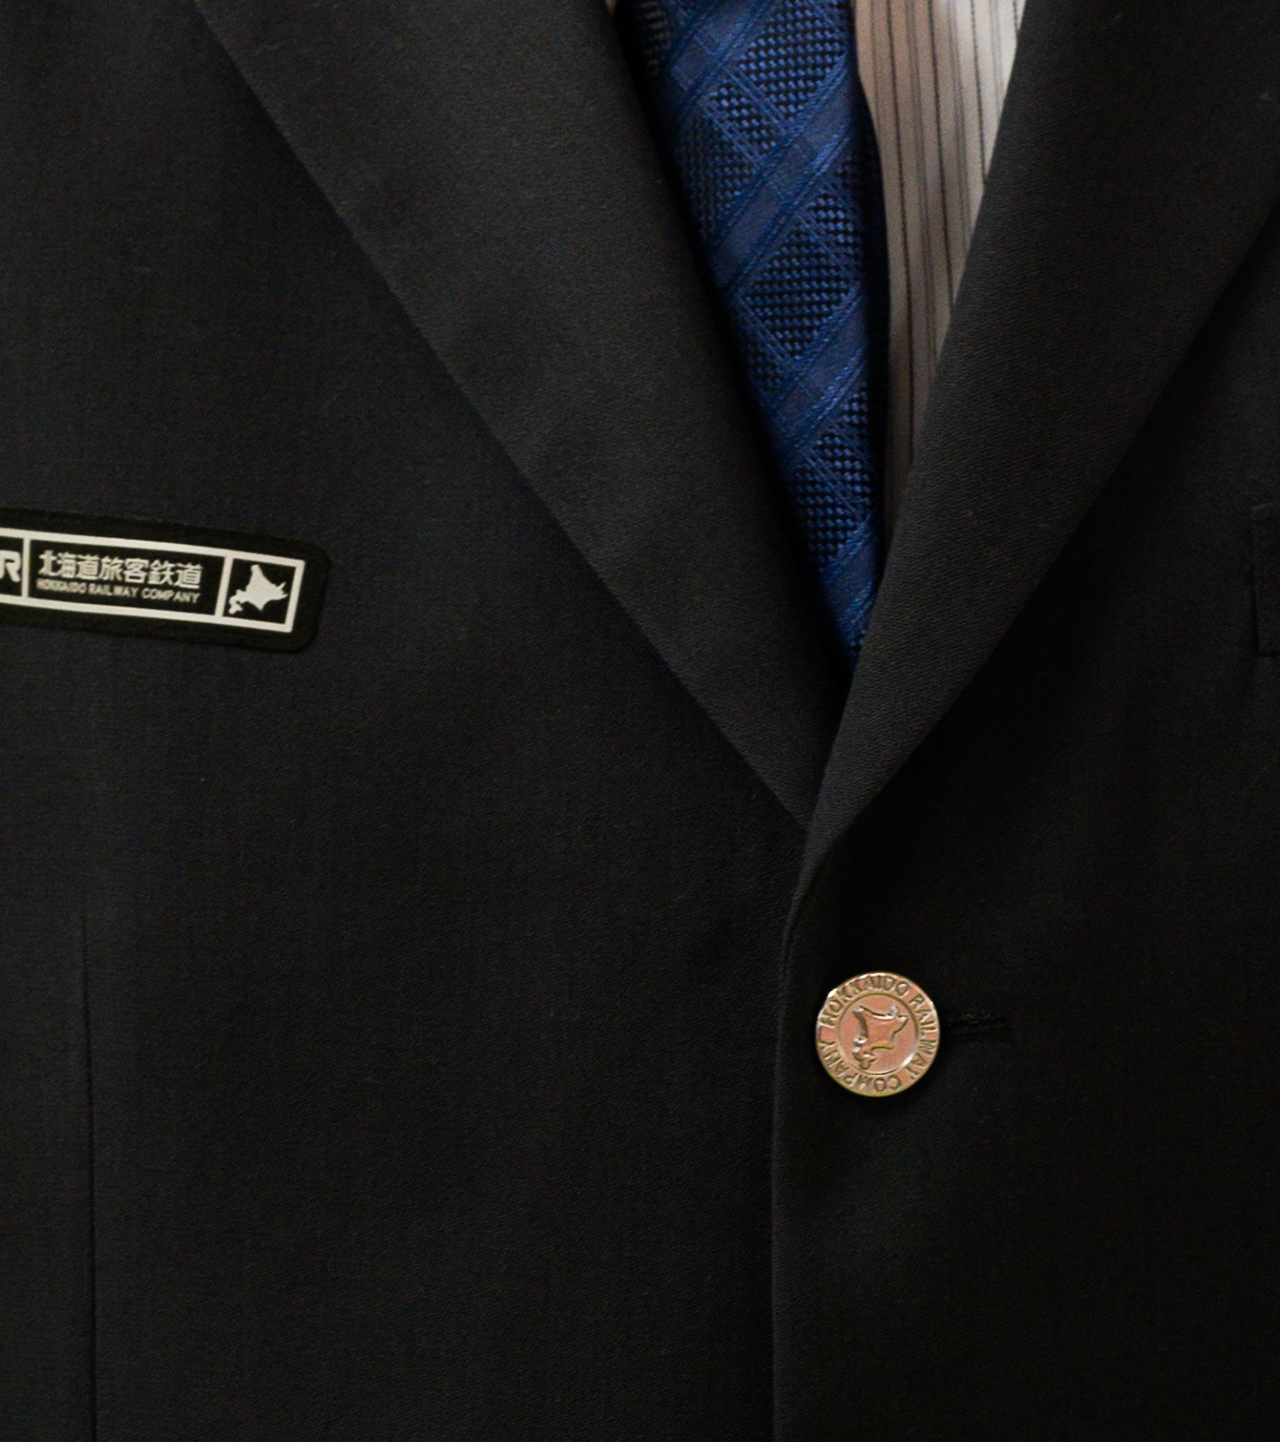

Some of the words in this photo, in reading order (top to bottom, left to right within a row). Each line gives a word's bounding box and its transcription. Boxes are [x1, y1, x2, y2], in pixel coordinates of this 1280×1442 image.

[38, 549, 203, 590] 北海道旅客鉄道
[35, 578, 87, 594] HOKKAIDO
[88, 582, 139, 598] RAILWAY
[141, 587, 202, 604] COMPANY
